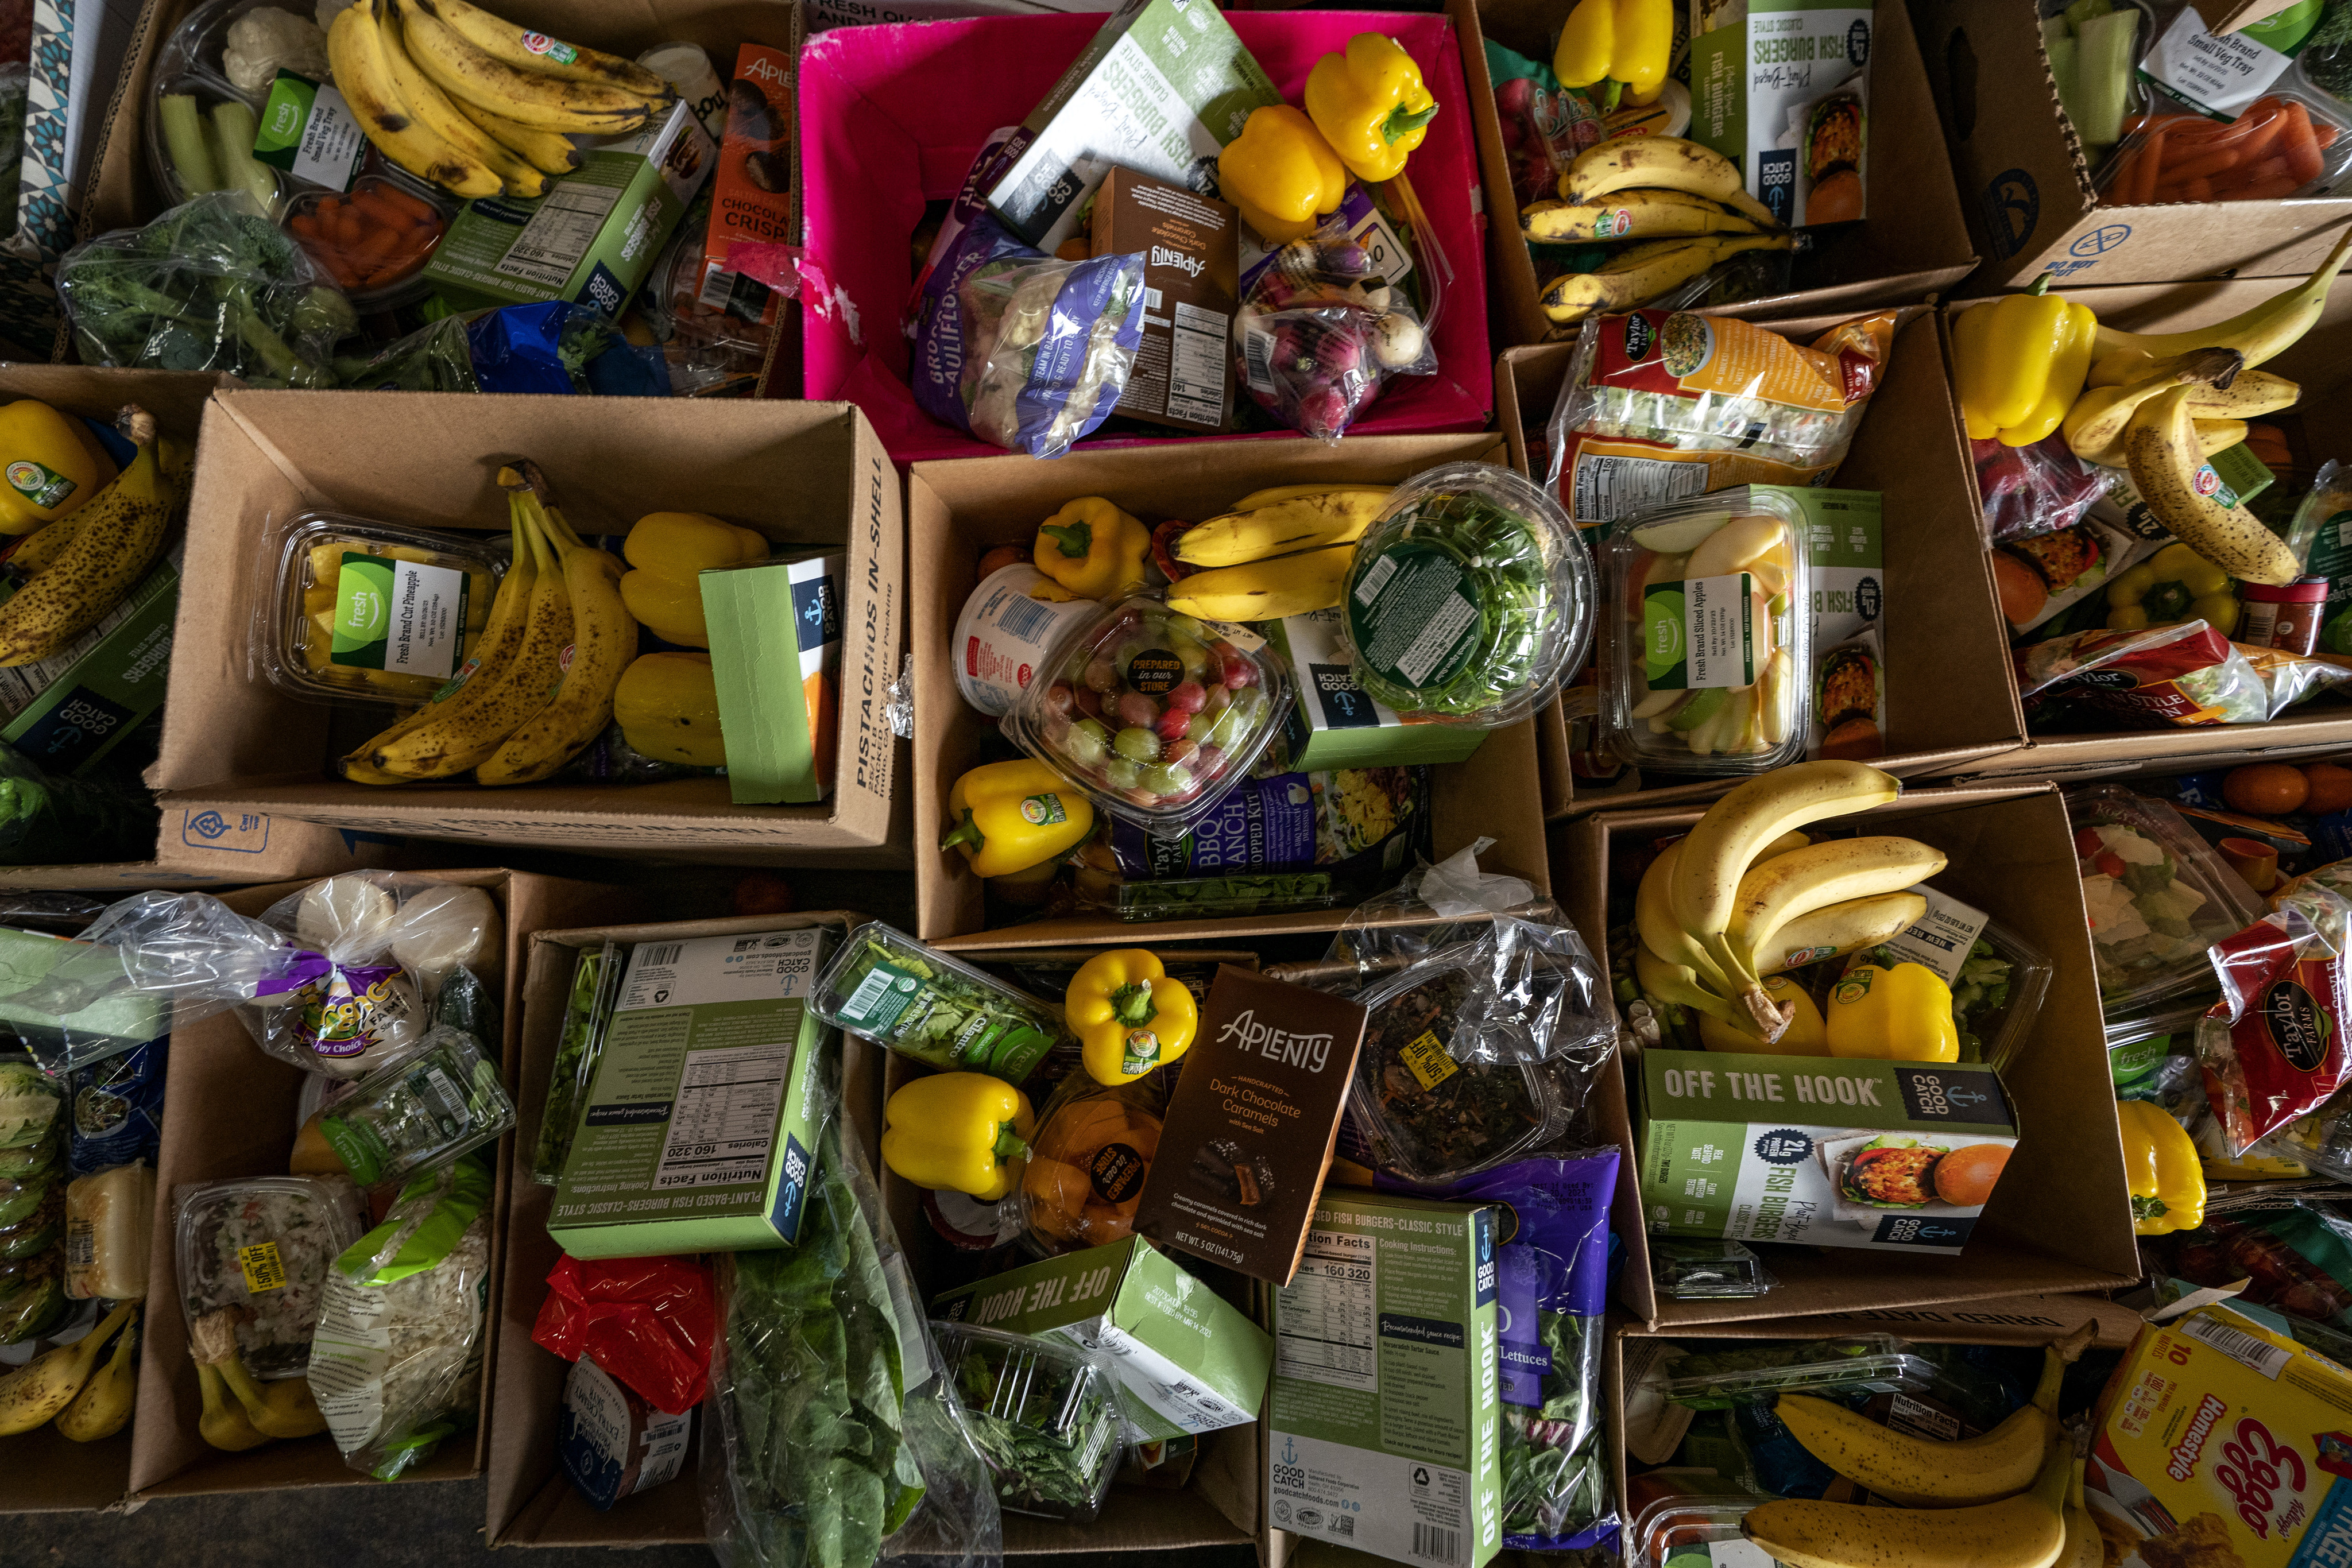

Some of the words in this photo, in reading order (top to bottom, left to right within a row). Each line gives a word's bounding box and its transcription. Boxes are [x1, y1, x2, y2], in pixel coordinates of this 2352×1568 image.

[1753, 20, 1774, 33] STYLE
[1776, 17, 1802, 32] CLASSIC
[1118, 43, 1145, 71] STYLE
[1753, 36, 1815, 64] BURGERS
[1818, 35, 1845, 59] FISH
[2186, 31, 2218, 56] Small
[2211, 46, 2235, 68] Veg
[2229, 55, 2257, 80] Tray
[2228, 35, 2262, 61] Brand
[1710, 51, 1725, 80] FISH
[1137, 67, 1171, 103] CLASSIC
[1096, 57, 1170, 137] BURGERS
[323, 105, 338, 125] Tray
[1709, 81, 1724, 138] BURGERS
[302, 130, 316, 154] Fresh
[310, 106, 324, 131] Brand
[317, 124, 331, 140] Veg
[310, 138, 325, 162] Small
[1156, 126, 1198, 169] FISH
[1762, 161, 1792, 174] CATCH
[1762, 172, 1791, 185] GOOD
[1032, 169, 1067, 207] GOOD
[513, 245, 529, 255] 320
[530, 249, 545, 258] 160
[551, 251, 577, 264] Calories
[500, 262, 523, 275] Facts
[1148, 244, 1207, 279] APLENTY
[525, 268, 564, 286] Nutrition
[587, 282, 615, 312] GOOD
[593, 273, 620, 304] CATCH
[1624, 313, 1643, 354] Taylor
[1167, 406, 1187, 418] Facts
[1188, 411, 1220, 425] Nutrition
[1576, 465, 1585, 486] Facts
[1601, 458, 1612, 473] 150
[401, 570, 420, 606] Pineapple
[1692, 580, 1707, 607] Apples
[349, 592, 368, 628] fresh
[401, 605, 413, 620] Cut
[1692, 609, 1705, 632] Sliced
[397, 618, 412, 642] Brand
[856, 599, 877, 788] PISTACHIOS
[867, 456, 880, 594] IN-SHELL
[394, 641, 410, 664] Fresh
[1693, 633, 1705, 657] Brand
[121, 636, 173, 683] BURGERS
[1132, 659, 1180, 671] PREPARED
[1694, 659, 1706, 680] Fresh
[1138, 669, 1151, 679] in
[1152, 671, 1173, 679] our
[1139, 680, 1170, 692] STORE
[1321, 682, 1359, 691] GOOD
[59, 707, 107, 734] GOOD
[67, 696, 117, 725] CATCH
[1291, 807, 1302, 831] RANCH
[1192, 814, 1225, 870] BBQ
[1216, 799, 1253, 877] RANCH
[1293, 833, 1302, 846] BBQ
[1906, 924, 1925, 938] REC
[1924, 933, 1947, 948] NEW
[745, 950, 811, 959] goodcatchfoods.com
[777, 958, 810, 966] CATCH
[776, 965, 808, 974] GOOD
[2273, 993, 2304, 1058] Taylor
[2299, 1007, 2318, 1043] FARMS
[318, 1043, 331, 1054] by
[331, 1039, 363, 1055] Choice
[947, 1015, 988, 1058] Cilantro
[1216, 1010, 1333, 1074] APLENTY
[1409, 1038, 1430, 1060] OFF
[2120, 1045, 2157, 1063] fresh
[1005, 1045, 1038, 1078] fresh
[1419, 1052, 1444, 1080] 50%
[1209, 1078, 1240, 1098] Dark
[1239, 1089, 1303, 1118] Chocolate
[1913, 1074, 1933, 1115] CATCH
[1927, 1075, 1949, 1117] GOOD
[1220, 1097, 1281, 1127] Caramels
[667, 1147, 693, 1157] 320
[695, 1145, 717, 1155] 160
[728, 1139, 768, 1149] Calories
[1690, 1147, 1701, 1160] TASTE
[1700, 1144, 1713, 1164] SEAFOOD
[1712, 1149, 1723, 1160] REAL
[1768, 1137, 1781, 1157] PROTEIN
[1779, 1139, 1806, 1157] 21g
[787, 1148, 806, 1175] CATCH
[659, 1175, 696, 1186] Facts
[701, 1170, 762, 1182] Nutrition
[783, 1160, 804, 1187] GOOD
[1764, 1167, 1796, 1193] FISH
[571, 1183, 617, 1194] Instructions:
[617, 1179, 649, 1191] Cooking
[1684, 1178, 1696, 1195] TEXTURE
[1706, 1183, 1716, 1195] FLAKY
[557, 1203, 584, 1217] STYLE
[588, 1196, 670, 1214] BURGERS-CLASSIC
[672, 1196, 694, 1209] FISH
[697, 1191, 763, 1207] PLANT-BASED
[1170, 1200, 1197, 1214] chocolate
[1196, 1210, 1208, 1218] and
[1206, 1213, 1232, 1227] sprinkled
[1231, 1222, 1243, 1231] with
[1243, 1227, 1253, 1235] sea
[1252, 1229, 1265, 1238] salt
[1172, 1193, 1194, 1206] Creamy
[1192, 1201, 1218, 1213] caramels
[1216, 1209, 1238, 1221] covered
[1243, 1218, 1254, 1226] rich
[1253, 1221, 1267, 1231] dark
[1763, 1198, 1790, 1240] BURGERS
[1333, 1211, 1352, 1225] FISH
[1354, 1214, 1433, 1234] BURGERS-CLASSIC
[1435, 1222, 1464, 1236] STYLE
[1889, 1218, 1907, 1242] CATCH
[1901, 1218, 1920, 1241] GOOD
[1336, 1235, 1371, 1248] Facts
[1378, 1238, 1409, 1251] Cooking
[1410, 1242, 1457, 1256] Instructions:
[248, 1245, 265, 1262] OFF
[252, 1262, 272, 1284] 50%
[1324, 1264, 1345, 1277] 160
[1347, 1267, 1371, 1280] 320
[1477, 1260, 1494, 1279] GOOD
[1067, 1264, 1110, 1303] OFF
[1477, 1273, 1494, 1292] CATCH
[974, 1285, 1027, 1325] HOOK
[1026, 1275, 1067, 1313] THE
[1380, 1319, 1426, 1338] Recommended
[1425, 1330, 1442, 1340] sauce
[2150, 1333, 2172, 1360] WAFFLES
[2165, 1340, 2194, 1368] 10
[1481, 1326, 1494, 1410] HOOK
[2148, 1375, 2165, 1392] 180
[2167, 1380, 2178, 1392] PER
[1894, 1394, 1932, 1419] Nutrition
[1932, 1411, 1958, 1431] Facts
[2156, 1392, 2172, 1413] WAFFLES
[2161, 1392, 2228, 1485] Homestyle
[1480, 1418, 1494, 1482] THE
[1272, 1474, 1305, 1489] CATCH
[1273, 1464, 1305, 1478] GOOD
[2215, 1416, 2308, 1541] Eggo
[1273, 1486, 1339, 1508] goodcatchfoods.com
[1482, 1492, 1496, 1547] OFF
